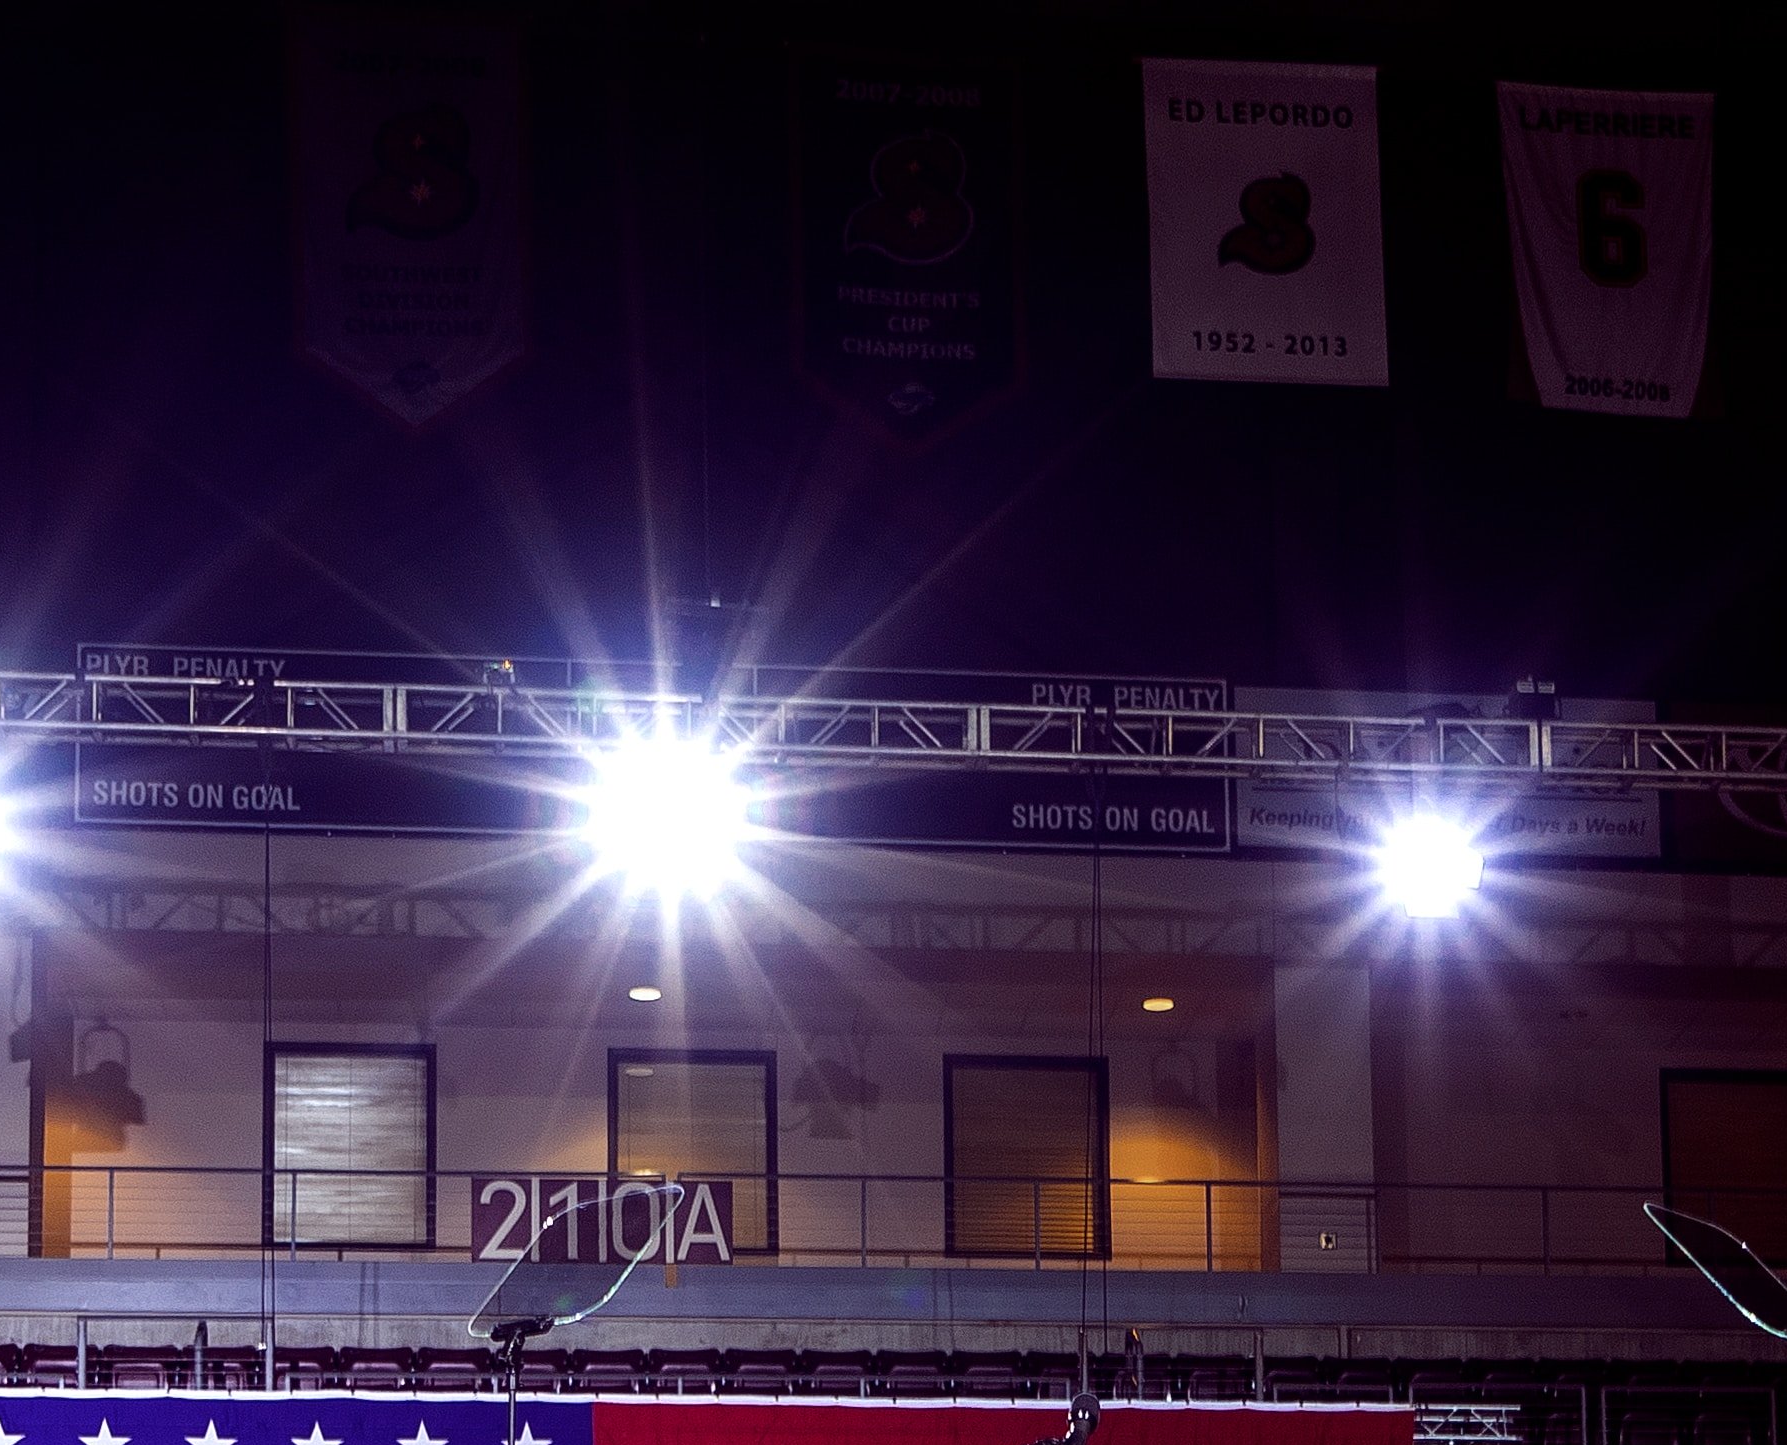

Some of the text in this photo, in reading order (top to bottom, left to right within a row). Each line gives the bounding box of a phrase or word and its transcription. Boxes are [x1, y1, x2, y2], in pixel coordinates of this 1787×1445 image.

[1167, 99, 1354, 129] ED LEPORDO
[1519, 106, 1696, 140] LAPERRIERE
[1575, 168, 1648, 288] 6
[1193, 331, 1256, 354] 1952
[1284, 335, 1348, 357] 2013
[1564, 374, 1671, 403] 2006-2008
[1031, 683, 1219, 711] PLYR PENALTY
[93, 781, 301, 812] SHOTS ON GOAL
[1012, 804, 1215, 834] SHOTS ON GOAL
